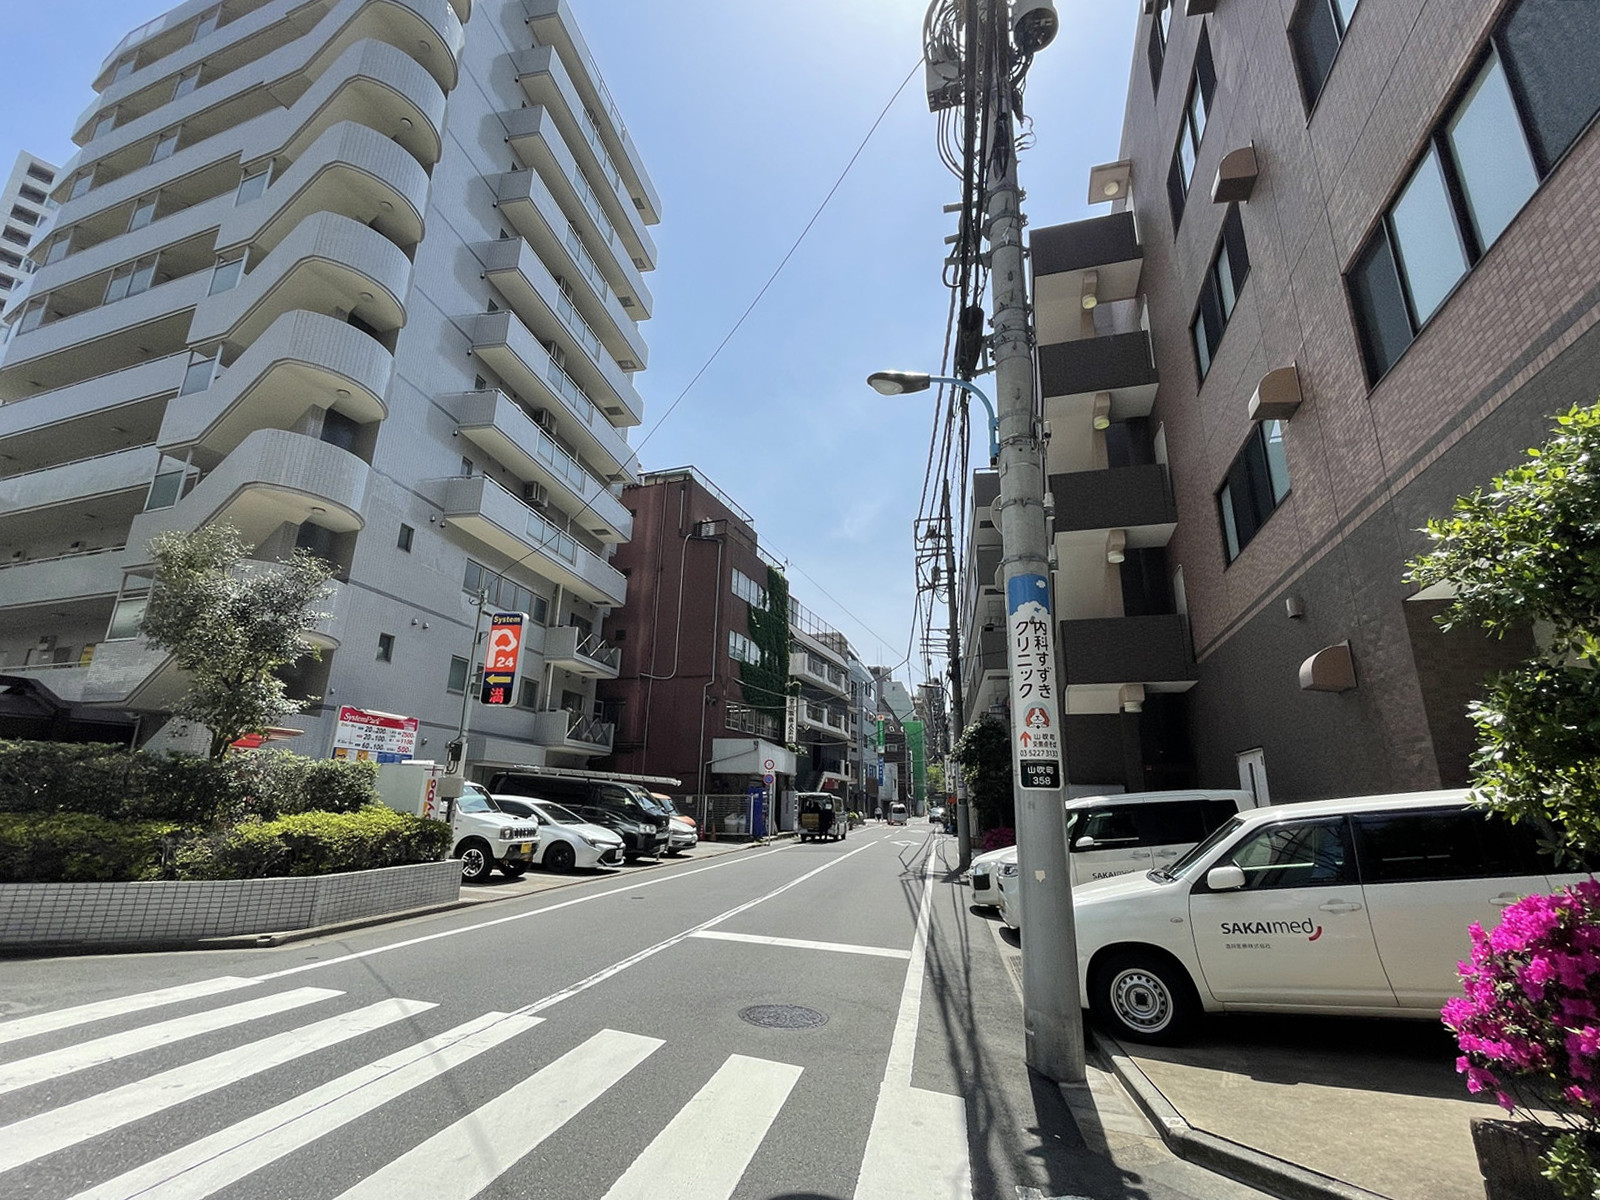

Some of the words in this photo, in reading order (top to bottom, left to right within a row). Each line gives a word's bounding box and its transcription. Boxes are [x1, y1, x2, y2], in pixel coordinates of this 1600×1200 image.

[493, 616, 521, 624] System
[496, 656, 514, 668] 24
[1016, 621, 1033, 699] クリニック
[1033, 620, 1052, 699] 内科すずき
[1027, 765, 1054, 775] 山吹町
[1032, 776, 1052, 785] 358
[1220, 917, 1314, 935] SAKAImed
